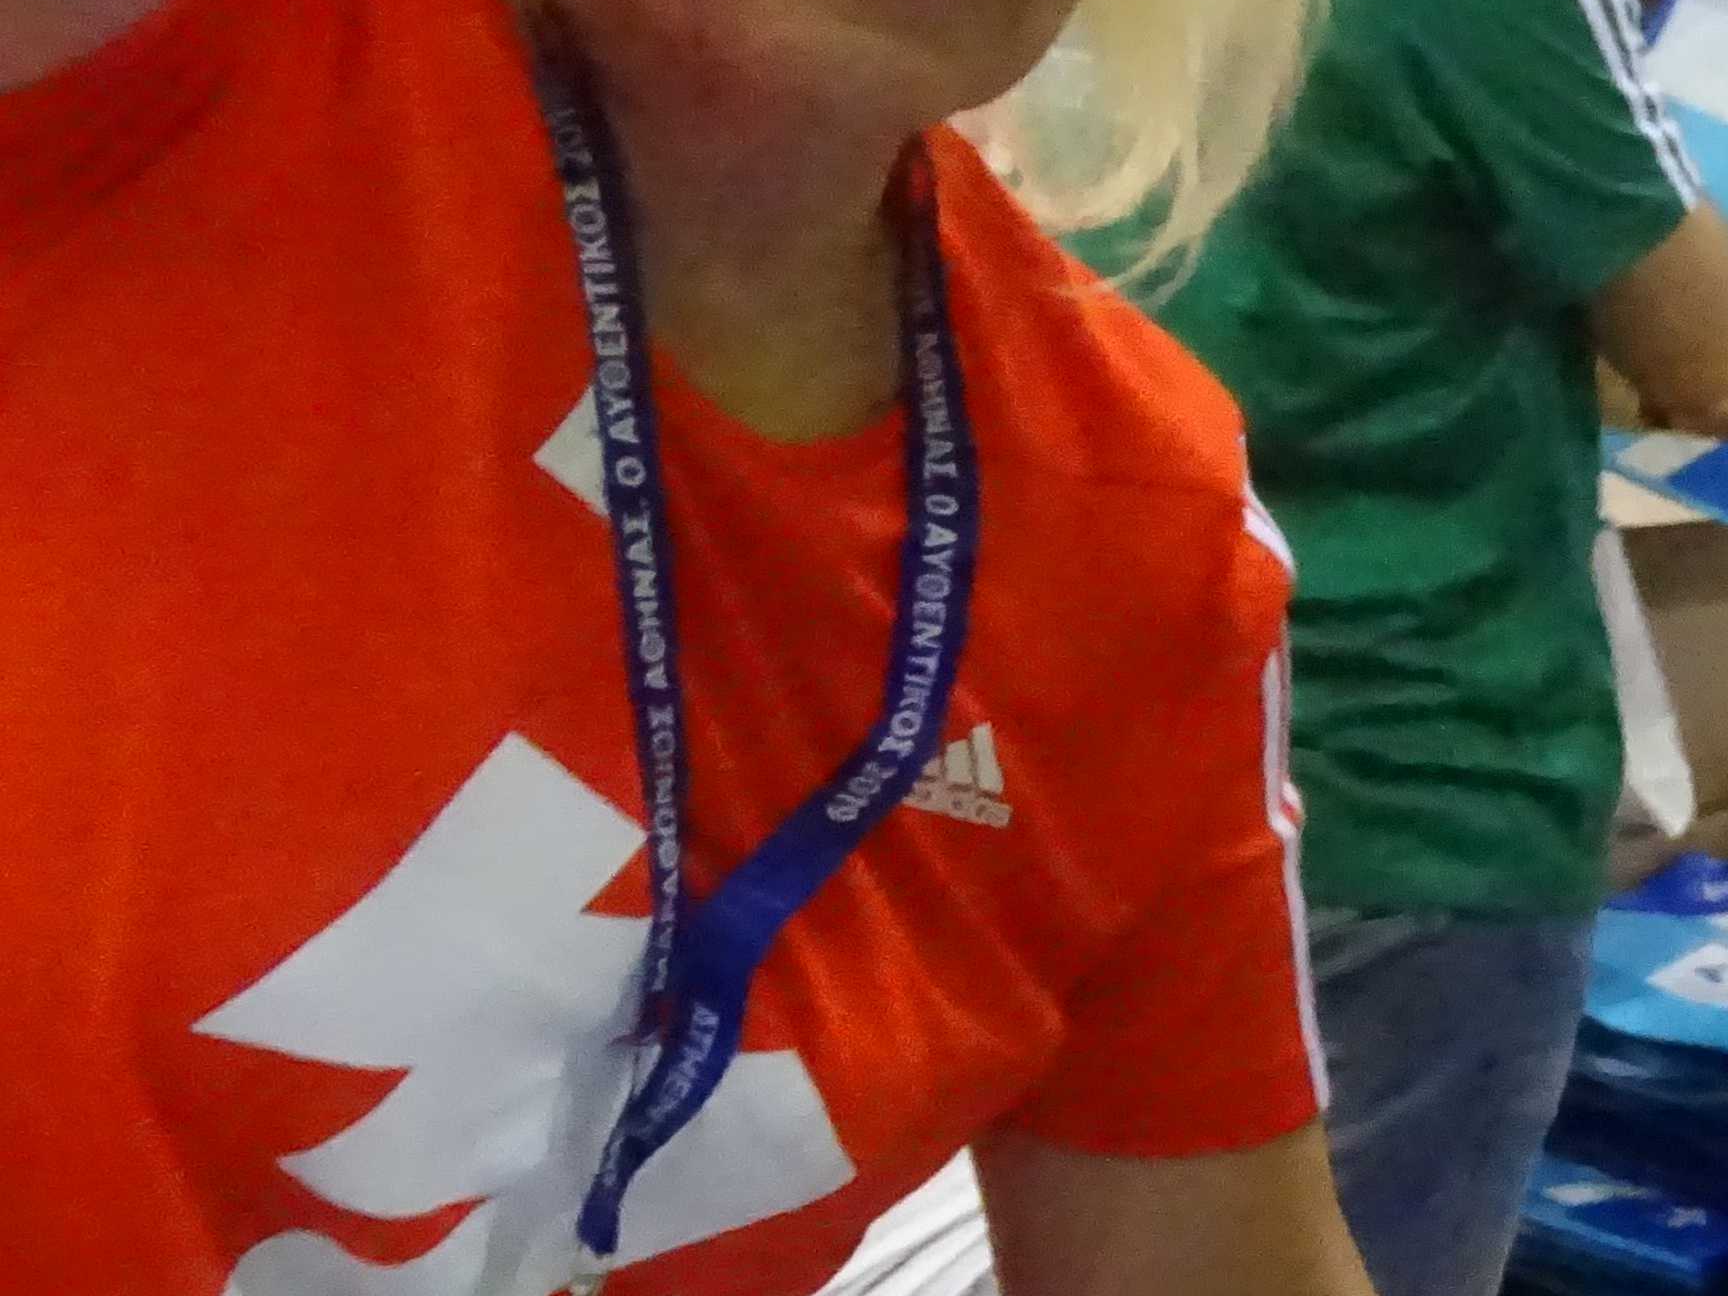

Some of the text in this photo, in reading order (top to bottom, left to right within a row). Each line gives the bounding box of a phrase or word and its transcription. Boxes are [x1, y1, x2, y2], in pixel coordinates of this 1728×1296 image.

[565, 175, 640, 444] ΑΥΘΕΝΤΙΚΟΣ
[614, 458, 647, 488] Ο
[924, 492, 959, 517] Ο
[877, 522, 960, 760] ΑΥΘΕΝΤΙΚΟΣ
